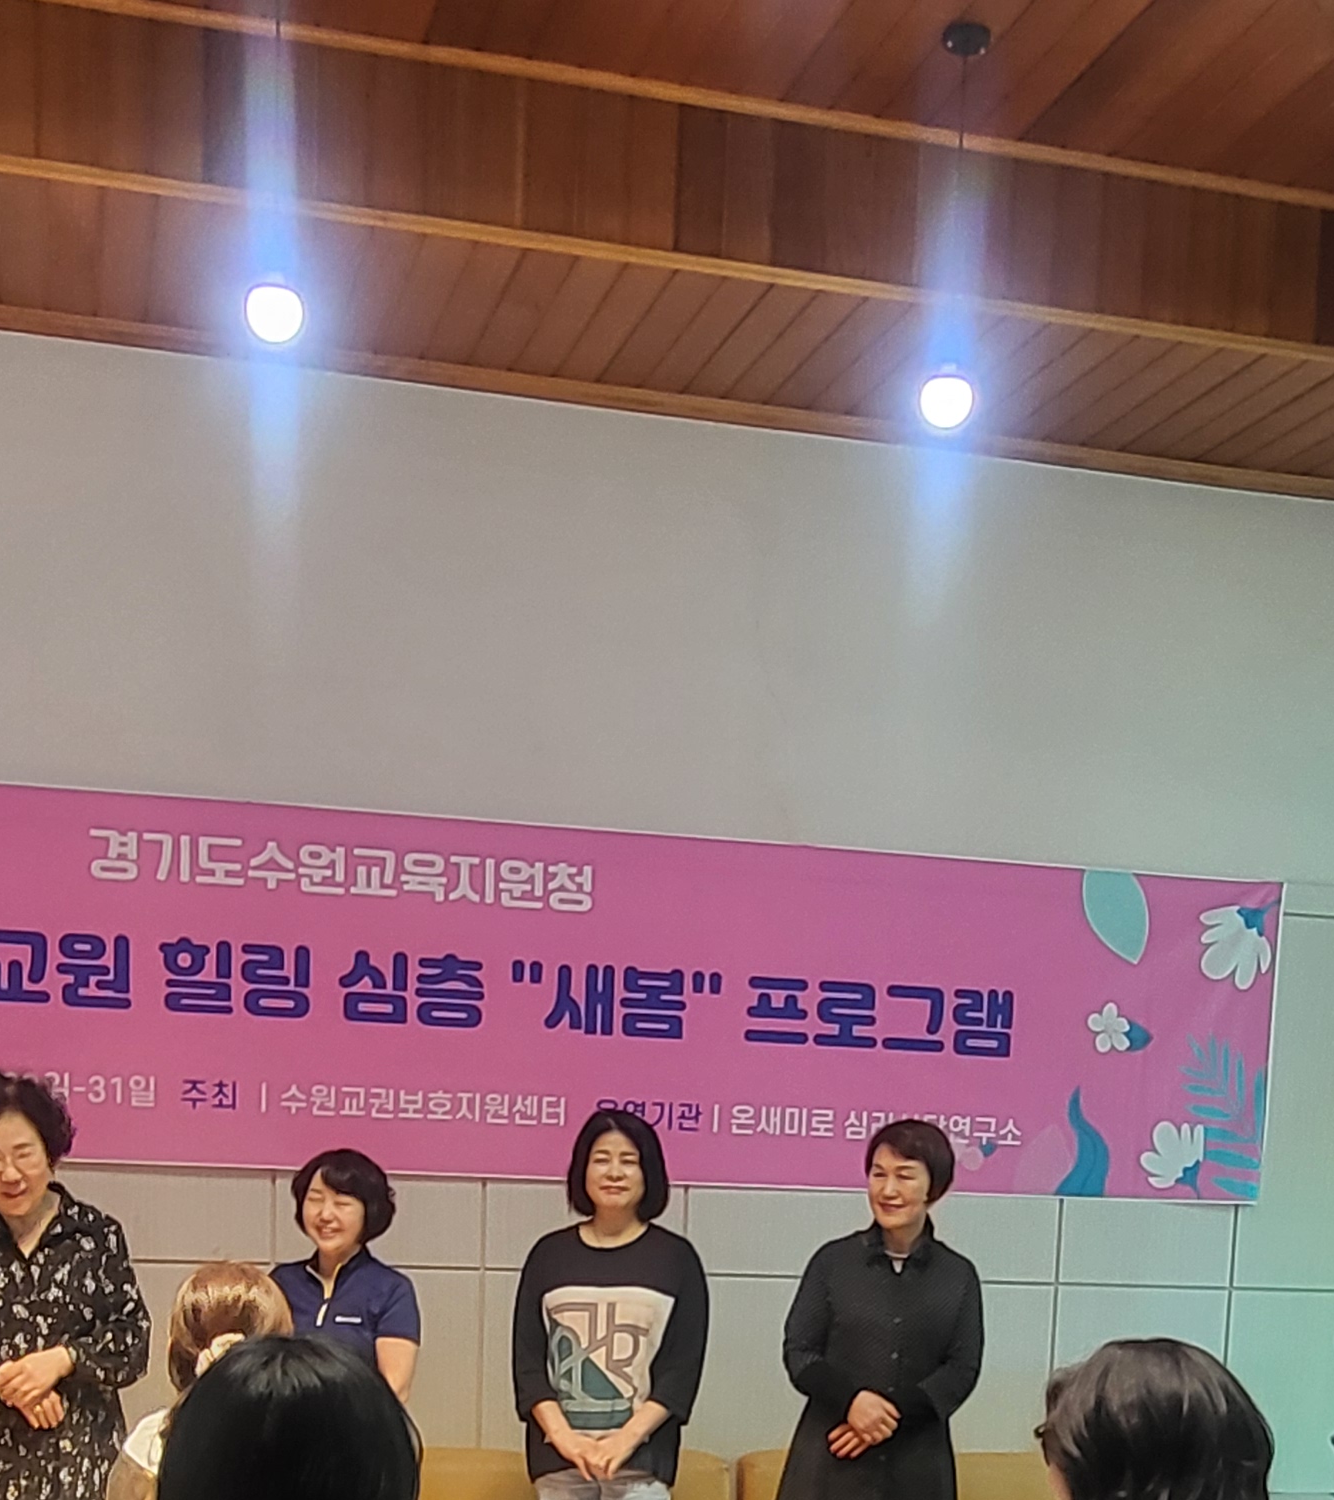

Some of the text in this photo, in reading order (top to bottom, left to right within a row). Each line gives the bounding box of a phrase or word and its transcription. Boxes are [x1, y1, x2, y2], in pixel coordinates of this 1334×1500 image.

[88, 828, 594, 913] 경기도수원교육지원청
[158, 936, 312, 1019] 힐링
[338, 949, 486, 1029] 심층
[510, 959, 723, 1041] "새봄"
[743, 974, 1016, 1059] 프로그램
[180, 1078, 239, 1111] 주최
[280, 1082, 567, 1127] 수원교권보호지원센터
[729, 1105, 836, 1138] 온새미로
